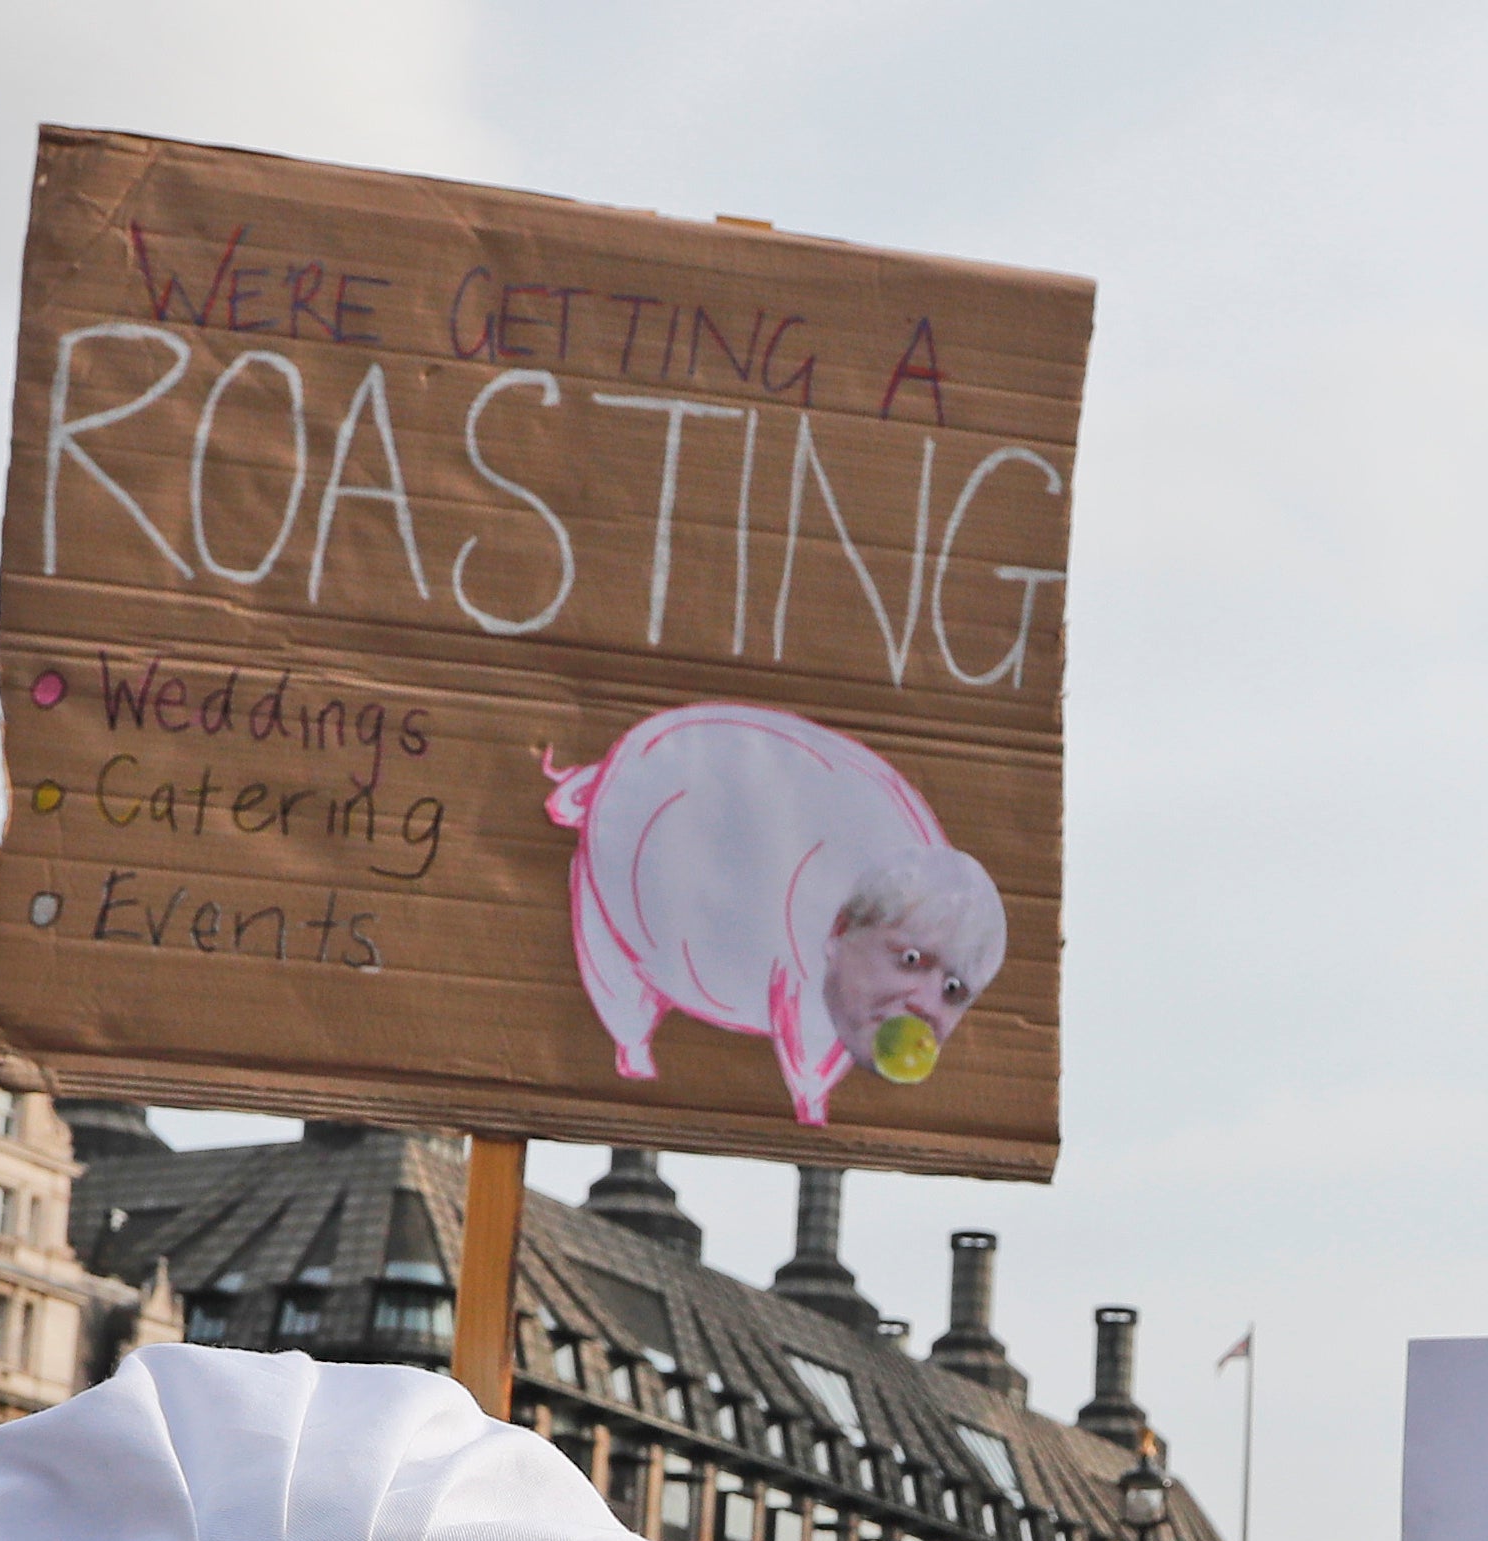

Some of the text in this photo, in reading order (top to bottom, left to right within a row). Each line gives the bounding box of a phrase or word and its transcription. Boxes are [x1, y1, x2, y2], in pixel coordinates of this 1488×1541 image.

[449, 265, 816, 408] GETTING
[880, 314, 947, 427] A
[42, 322, 1066, 690] ROASTING
[98, 649, 433, 789] Weddings
[95, 752, 445, 881] Catering
[93, 869, 383, 971] Events
